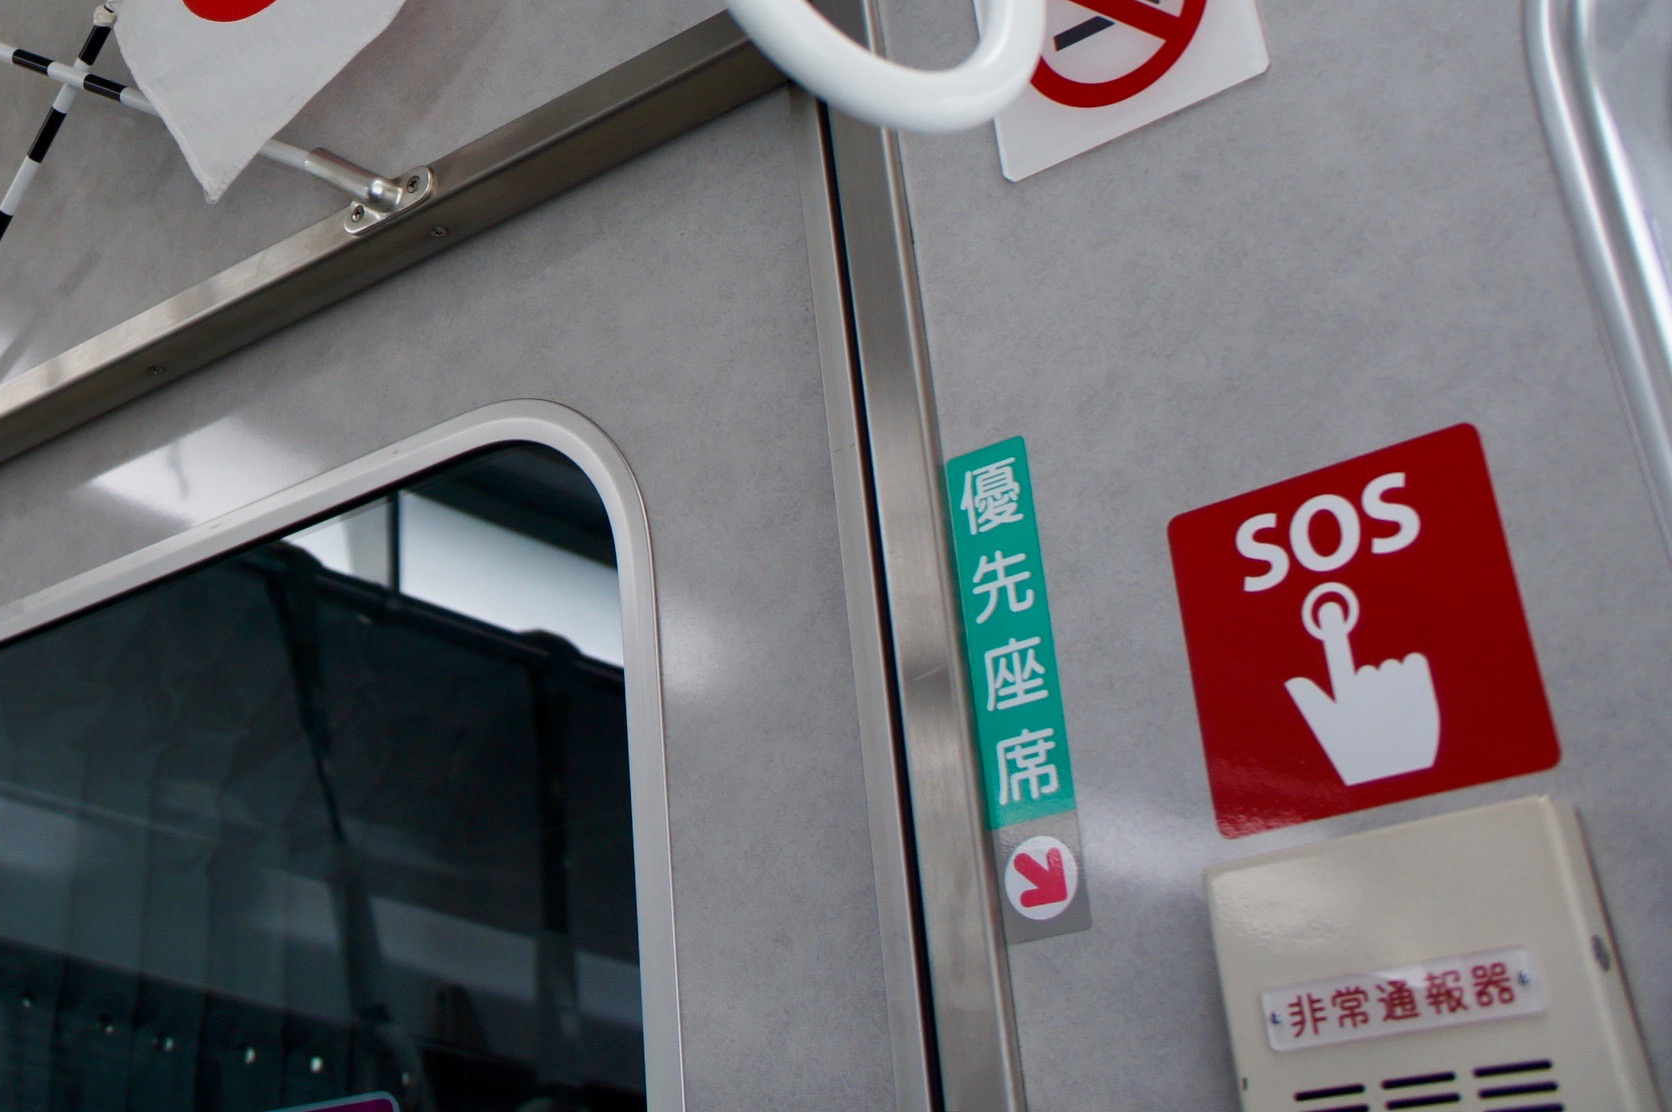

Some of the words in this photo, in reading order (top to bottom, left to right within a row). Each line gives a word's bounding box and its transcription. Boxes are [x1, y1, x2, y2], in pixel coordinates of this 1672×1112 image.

[1235, 472, 1421, 592] SOS
[960, 457, 1060, 805] 優先座席
[1287, 962, 1516, 1037] 非常通報器
